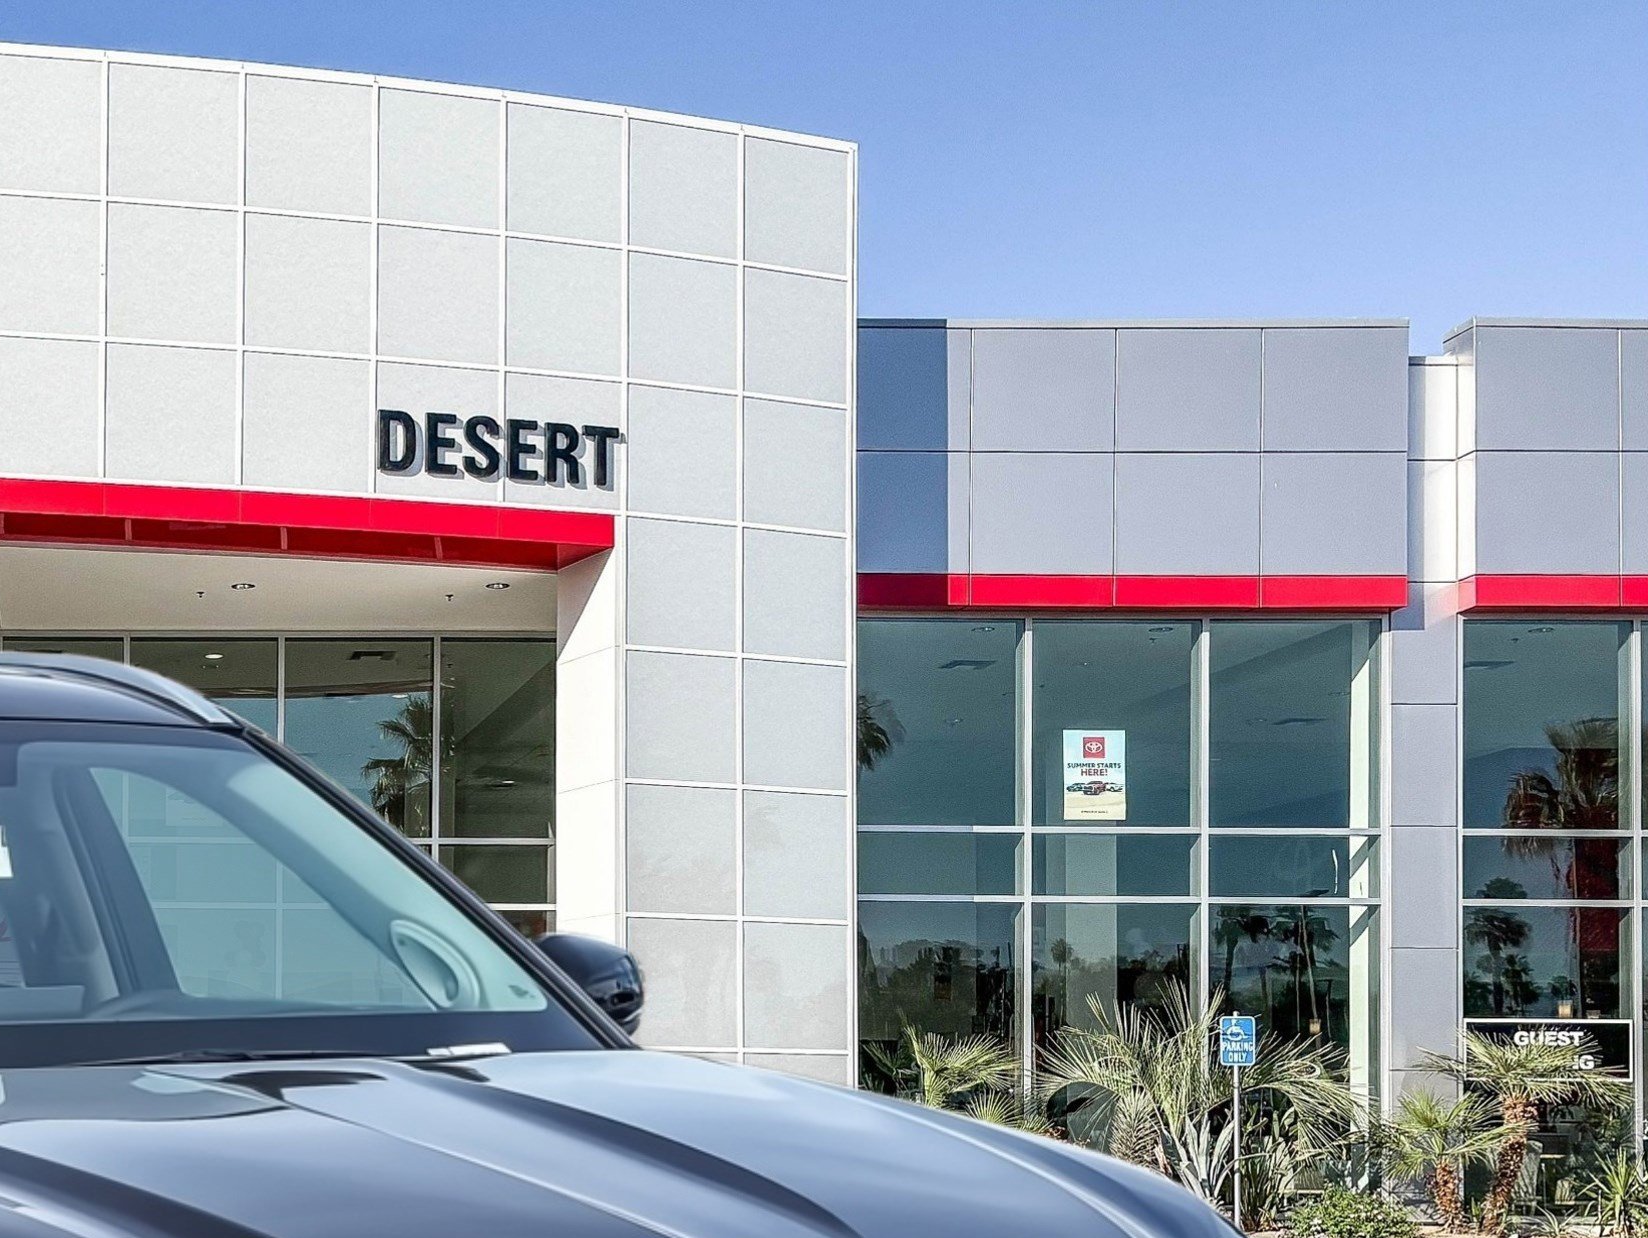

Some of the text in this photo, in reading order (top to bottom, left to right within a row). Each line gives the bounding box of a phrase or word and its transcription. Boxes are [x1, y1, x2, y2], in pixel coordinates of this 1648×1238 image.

[377, 409, 620, 487] DESERT
[1080, 768, 1108, 777] HERE!
[1513, 1030, 1584, 1046] GUEST
[1222, 1041, 1254, 1052] PARKING
[1228, 1052, 1247, 1062] ONLY
